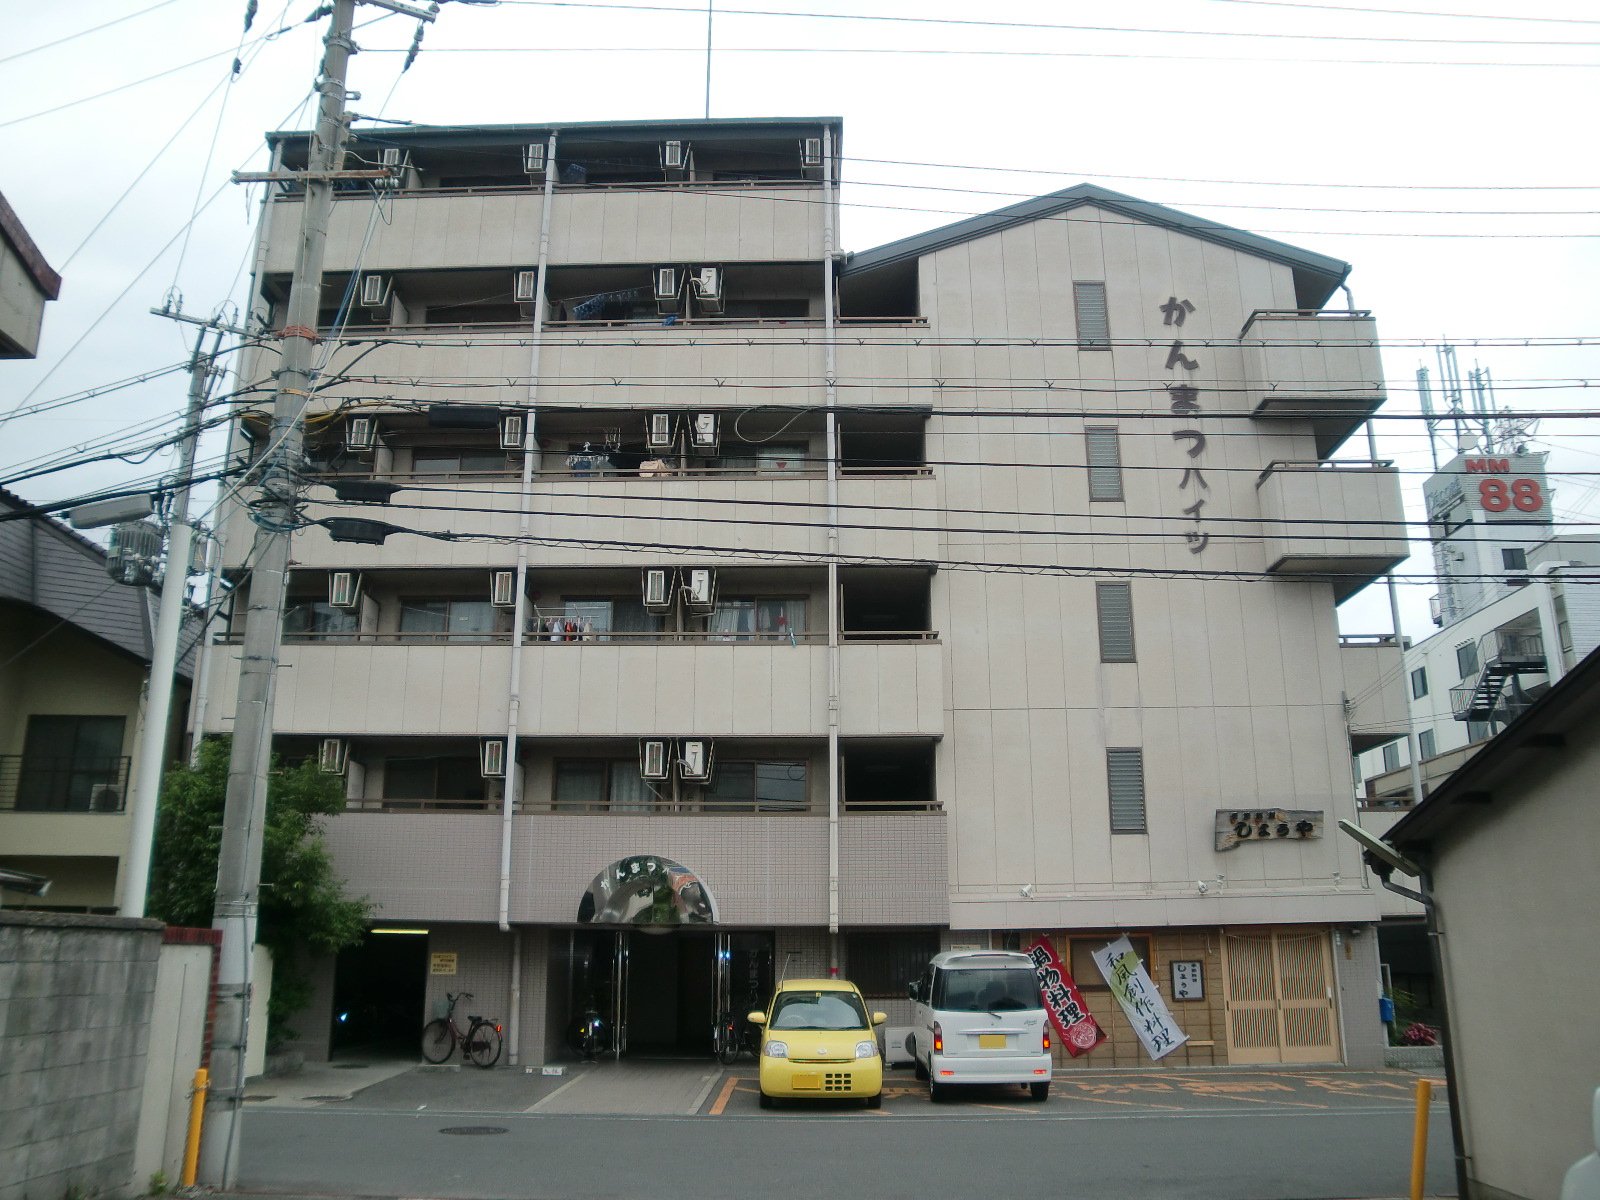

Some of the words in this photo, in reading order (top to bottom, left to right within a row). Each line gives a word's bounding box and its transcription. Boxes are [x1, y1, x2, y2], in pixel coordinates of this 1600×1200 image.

[1159, 296, 1209, 555] かんまつハイツ
[1464, 458, 1511, 473] MM
[1479, 479, 1544, 512] 88
[1028, 945, 1086, 1029] 鍋物料理
[1105, 951, 1176, 1053] 和風創作料理
